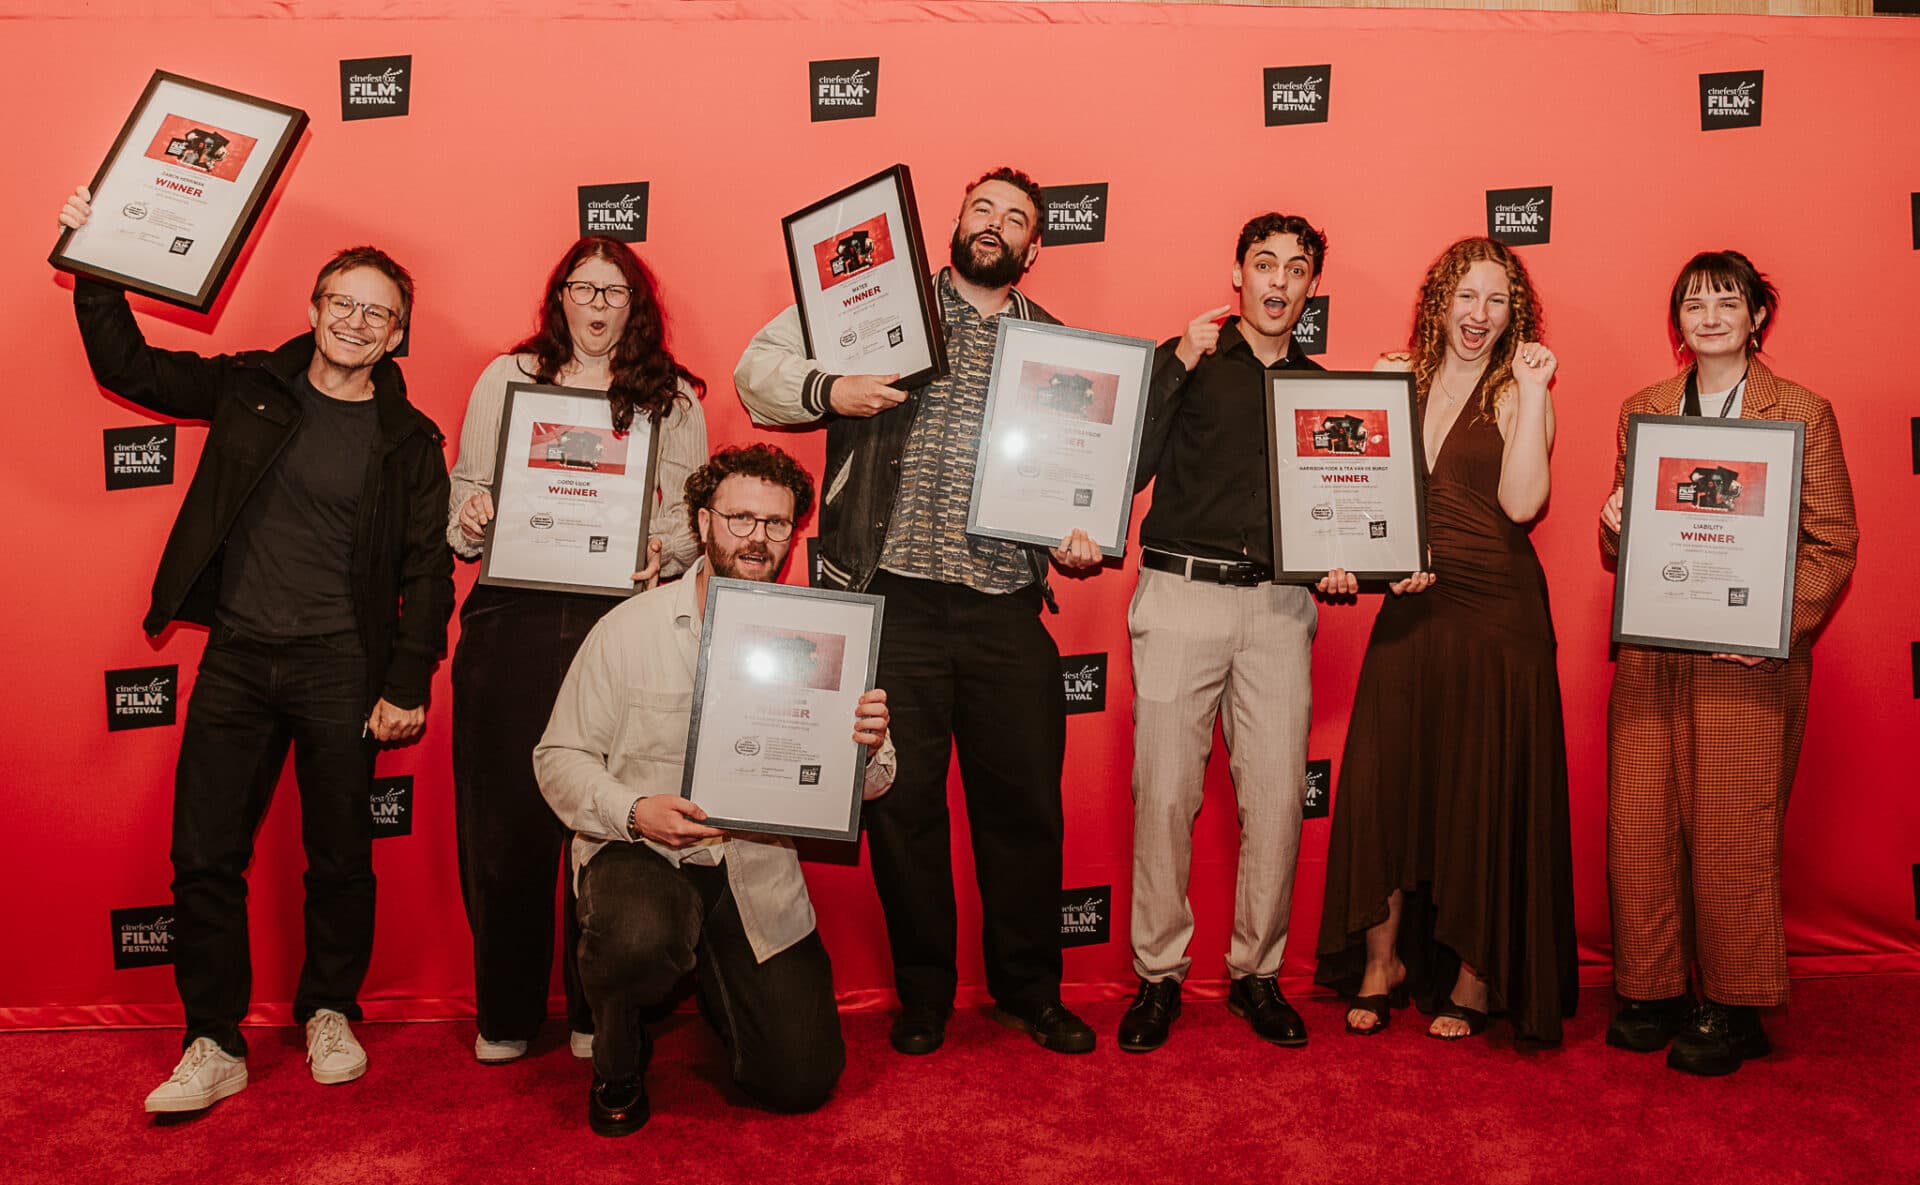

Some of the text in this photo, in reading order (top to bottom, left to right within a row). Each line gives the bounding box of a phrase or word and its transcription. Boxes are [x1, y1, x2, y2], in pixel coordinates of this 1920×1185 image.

[350, 83, 396, 96] FILM
[819, 84, 864, 98] FILM
[1273, 91, 1316, 103] FILM
[1708, 96, 1750, 108] FILM
[155, 177, 203, 198] WINNER
[588, 210, 634, 222] FILM
[1049, 210, 1093, 222] FILM
[1496, 213, 1538, 224] FILM
[588, 223, 633, 231] FESTIVAL
[842, 286, 882, 307] WINNER
[115, 452, 160, 465] FILM
[1322, 474, 1369, 482] WINNER
[548, 486, 598, 497] WINNER
[1680, 532, 1736, 544] WINNER
[1064, 680, 1092, 692] LM
[117, 693, 162, 706] FILM
[370, 804, 398, 816] LM
[1064, 912, 1096, 925] ILM
[122, 932, 168, 944] FILM
